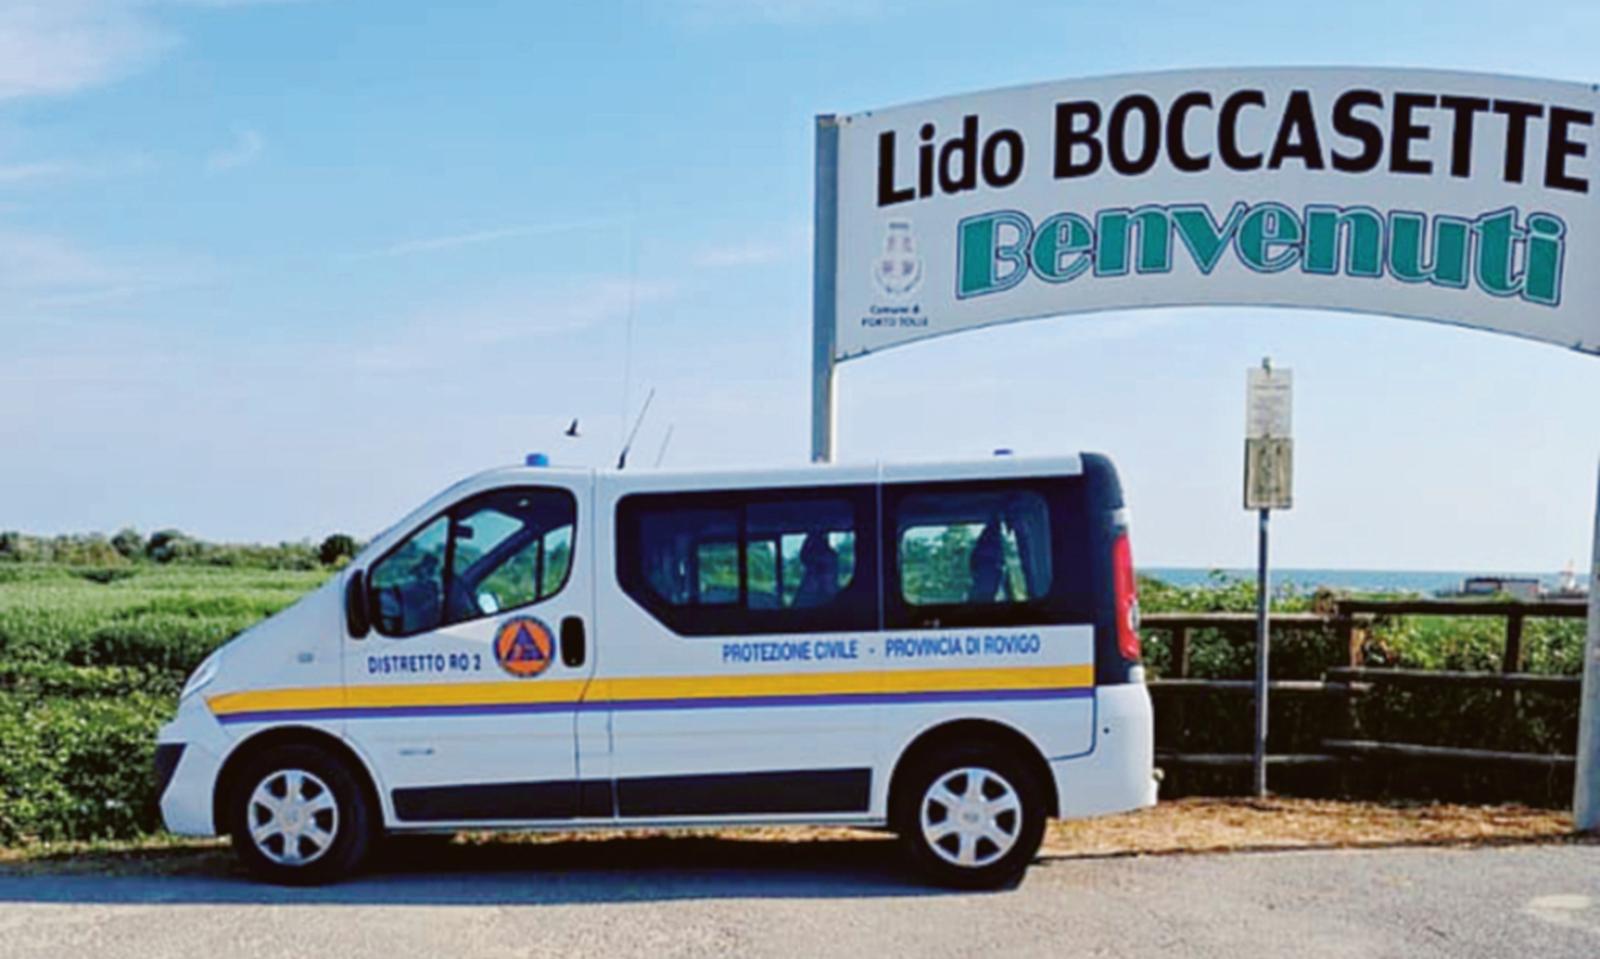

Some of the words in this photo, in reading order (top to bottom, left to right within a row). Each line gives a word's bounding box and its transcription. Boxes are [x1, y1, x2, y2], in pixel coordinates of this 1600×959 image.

[877, 114, 1025, 207] Lido
[1053, 89, 1595, 194] BOCCASETTE
[956, 201, 1567, 308] Benvenuti
[367, 654, 446, 674] DISTRETTO
[450, 653, 469, 672] RO
[473, 654, 482, 671] 2
[722, 642, 811, 663] PROTEZIONE
[814, 640, 859, 660] CIVILE
[885, 636, 961, 657] PROVINCIA
[965, 636, 982, 655] DI
[985, 633, 1041, 655] ROVIGO
